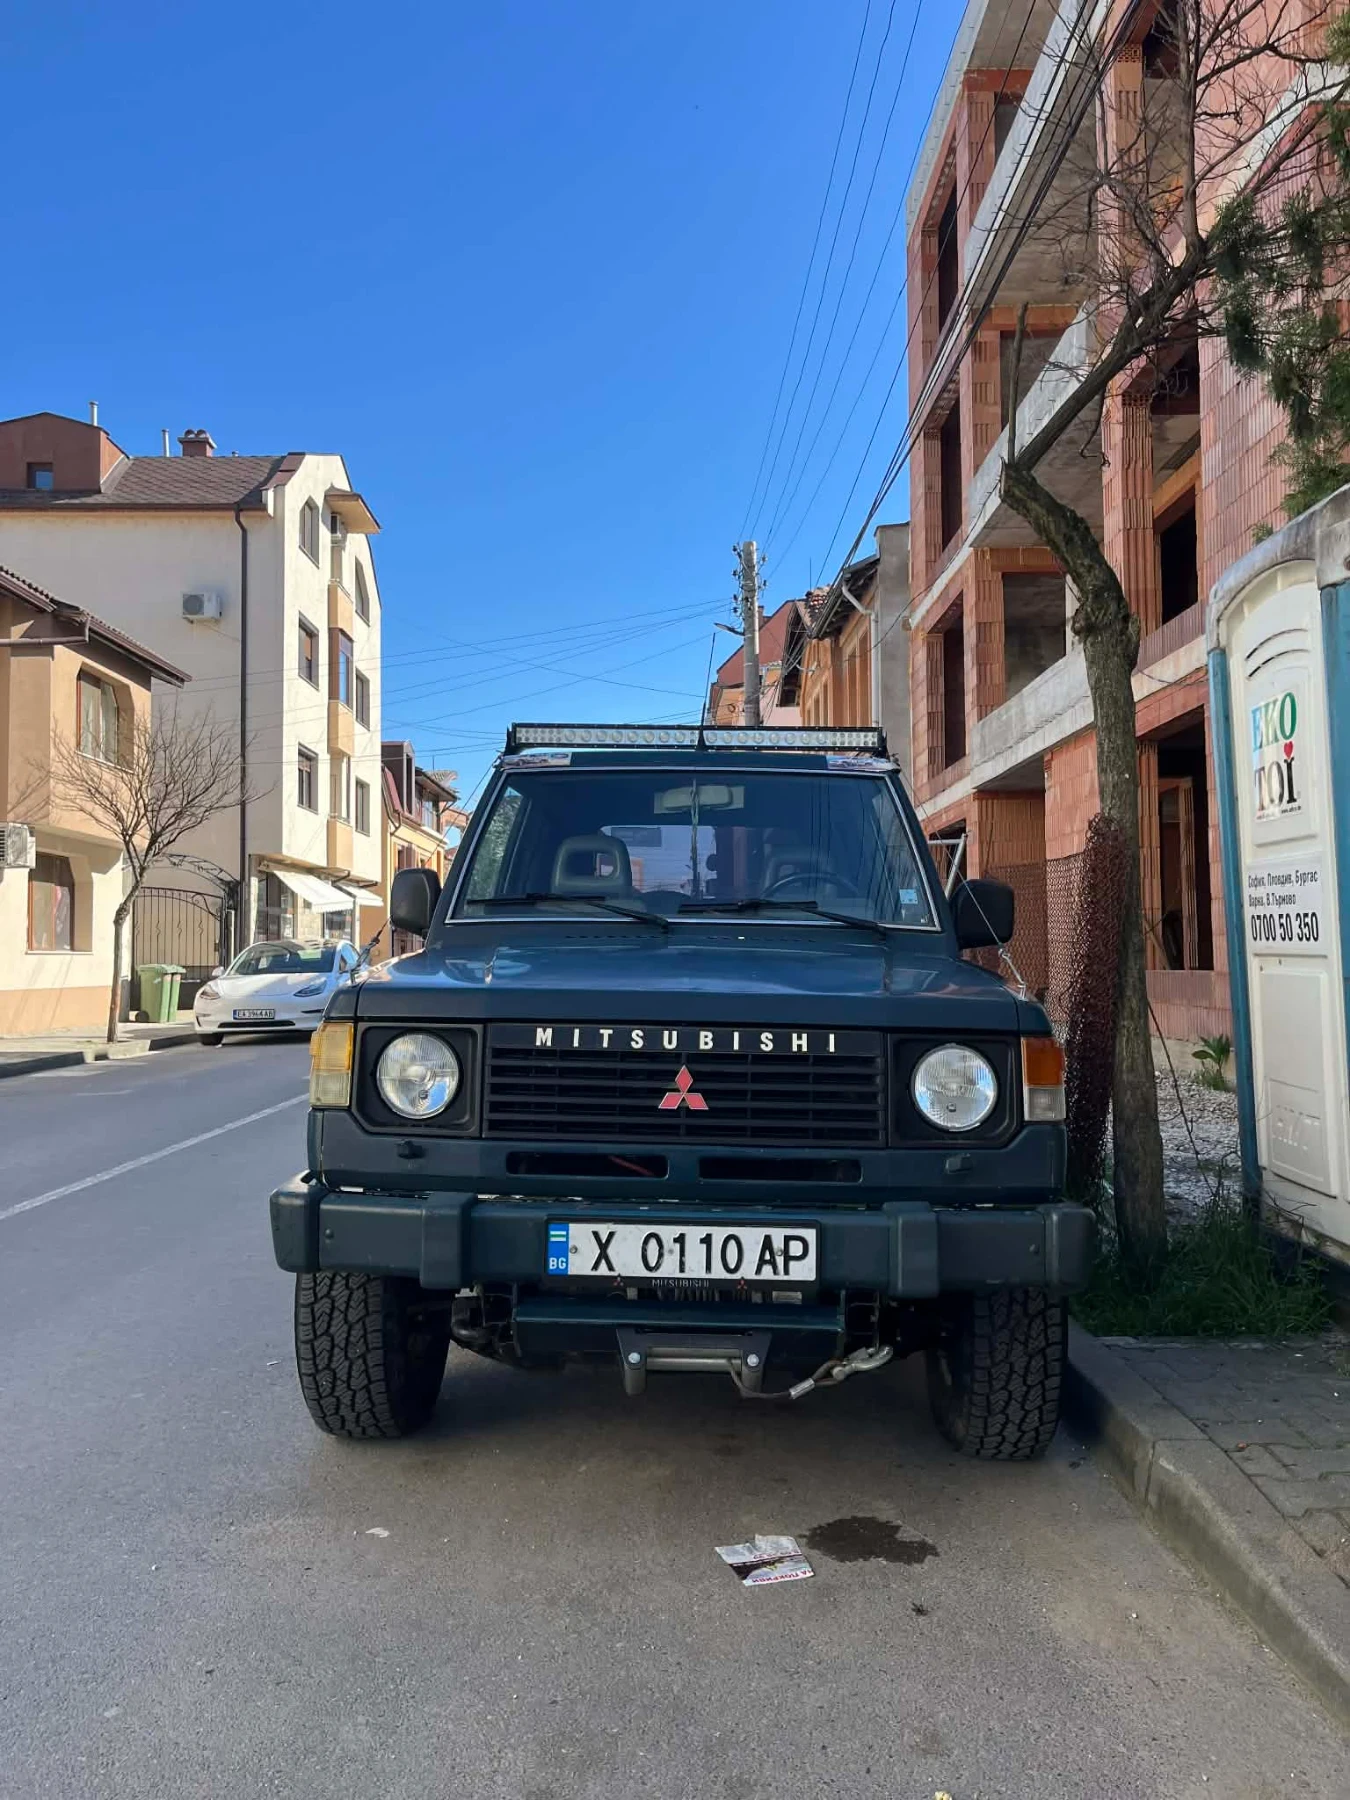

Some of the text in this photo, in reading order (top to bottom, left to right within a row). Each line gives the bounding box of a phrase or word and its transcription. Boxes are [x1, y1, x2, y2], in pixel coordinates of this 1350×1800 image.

[1251, 691, 1297, 752] EKO
[1295, 869, 1319, 887] Бургас
[1251, 912, 1319, 942] 0700 50 350
[535, 1027, 836, 1053] MITSUBISHI
[549, 1257, 566, 1270] BG
[591, 1230, 810, 1275] X 0110 AP
[652, 1279, 709, 1288] MITSUBISHI
